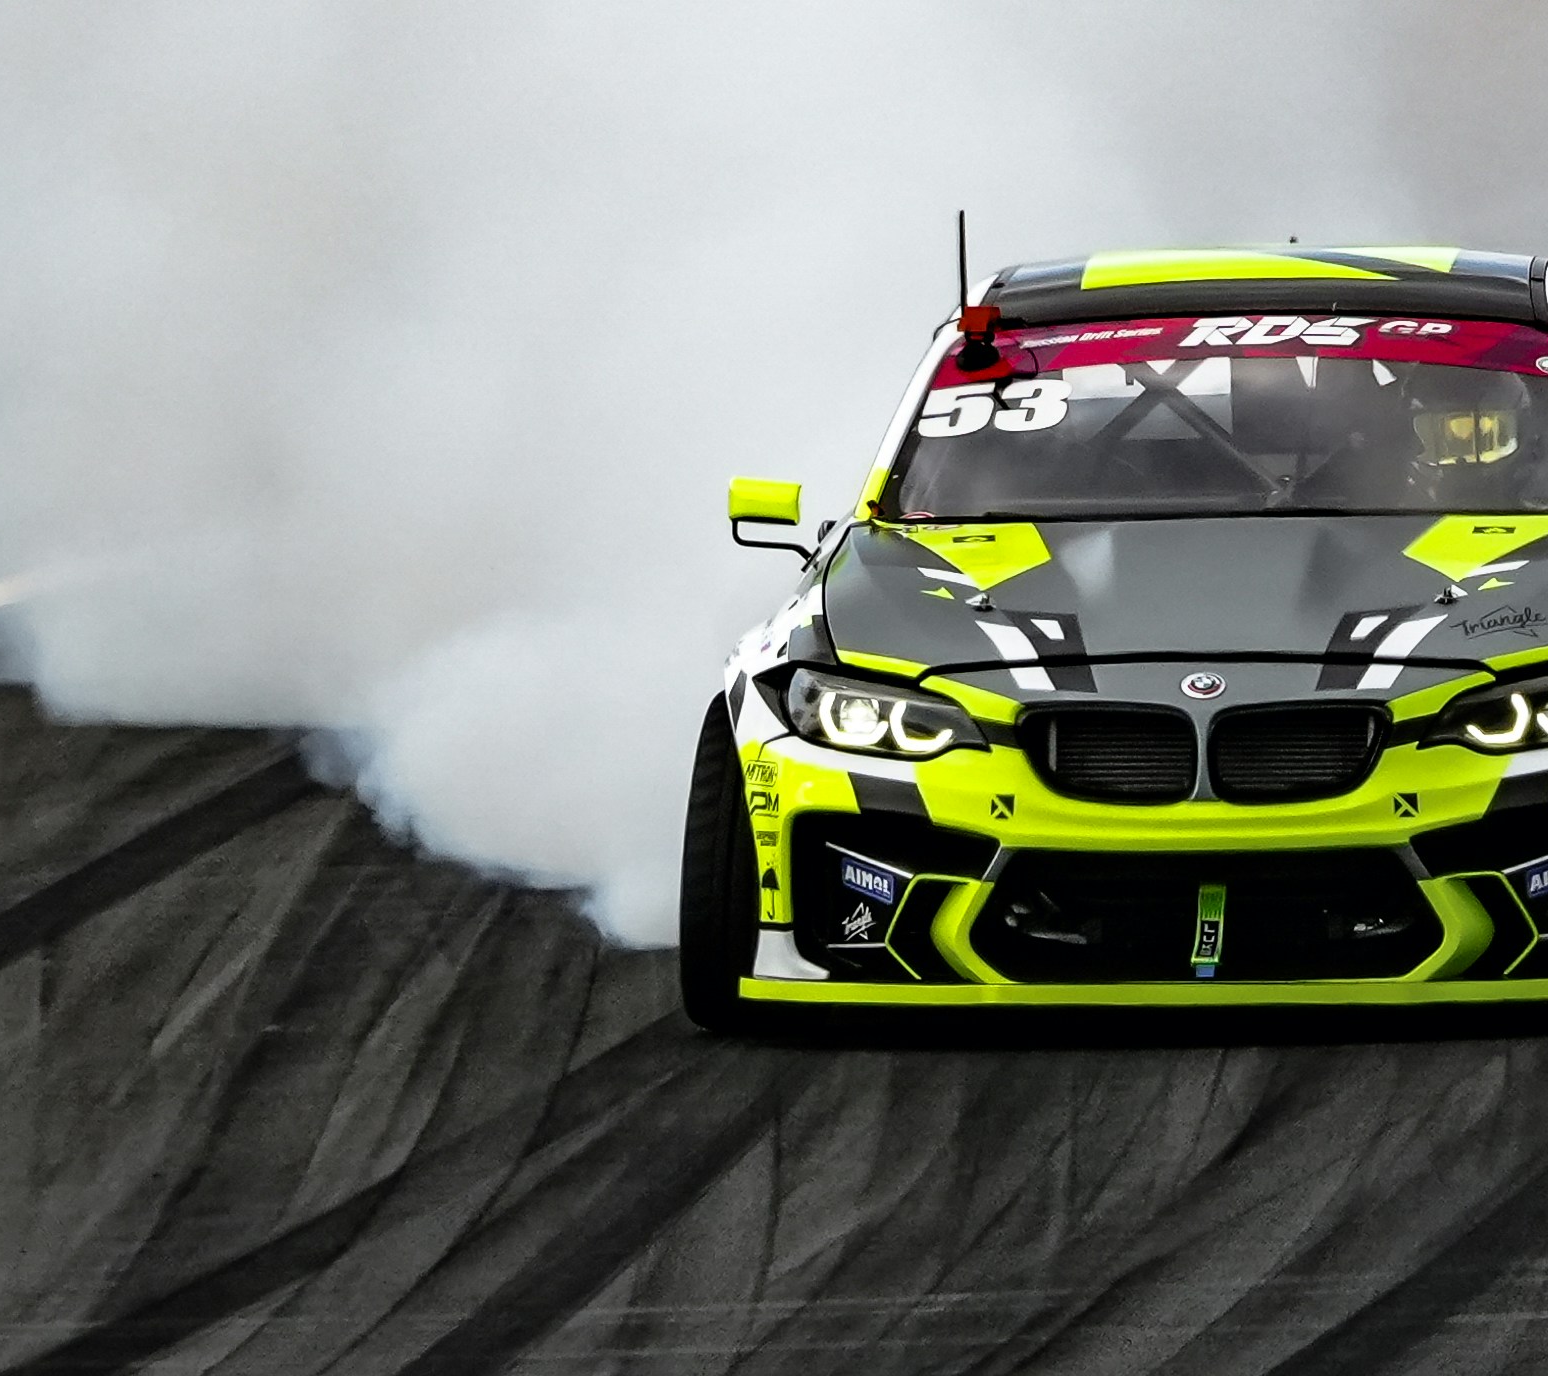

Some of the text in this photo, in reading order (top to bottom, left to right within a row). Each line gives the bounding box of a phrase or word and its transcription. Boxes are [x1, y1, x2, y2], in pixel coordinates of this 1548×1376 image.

[1079, 330, 1113, 342] Drift
[1177, 315, 1379, 347] RDS
[1378, 319, 1453, 336] GP
[917, 378, 1074, 438] 53
[845, 864, 891, 895] AIMOL
